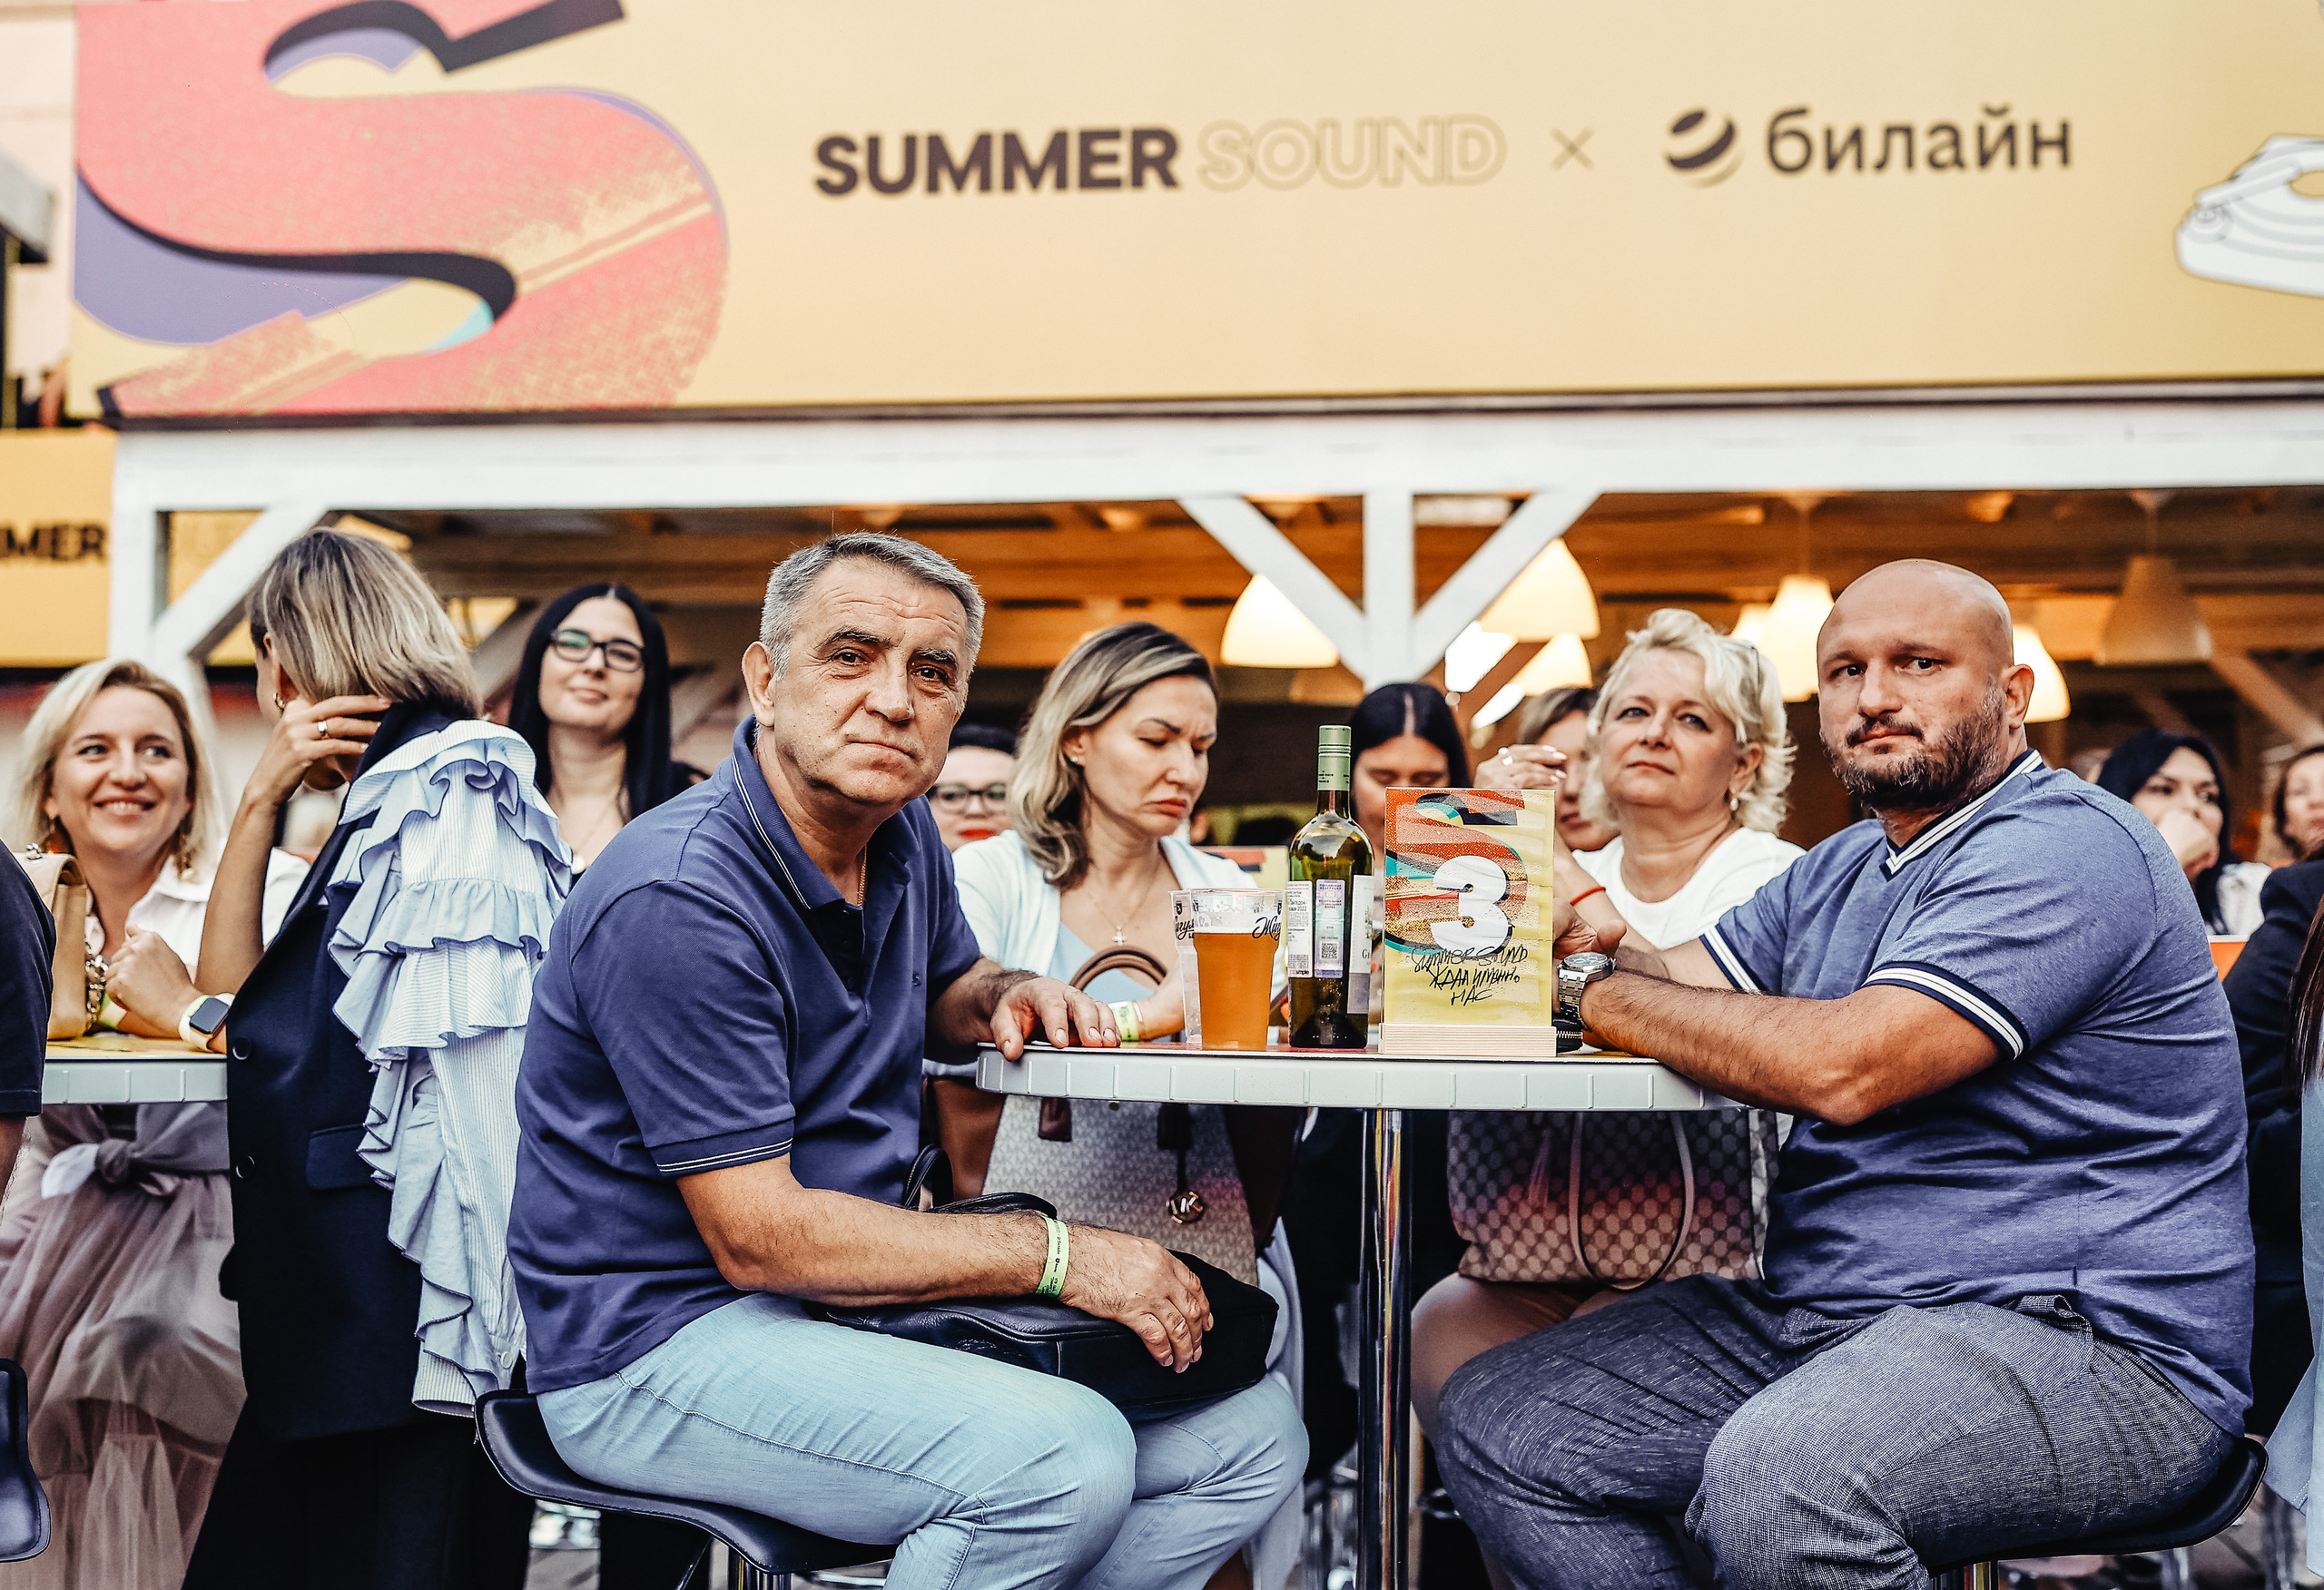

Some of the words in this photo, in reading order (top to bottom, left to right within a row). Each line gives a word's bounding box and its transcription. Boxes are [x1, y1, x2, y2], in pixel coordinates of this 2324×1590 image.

[814, 125, 1180, 197] SUMMER
[1196, 114, 1508, 193] SOUND
[1766, 104, 2072, 176] билайн
[1431, 855, 1512, 957] 3
